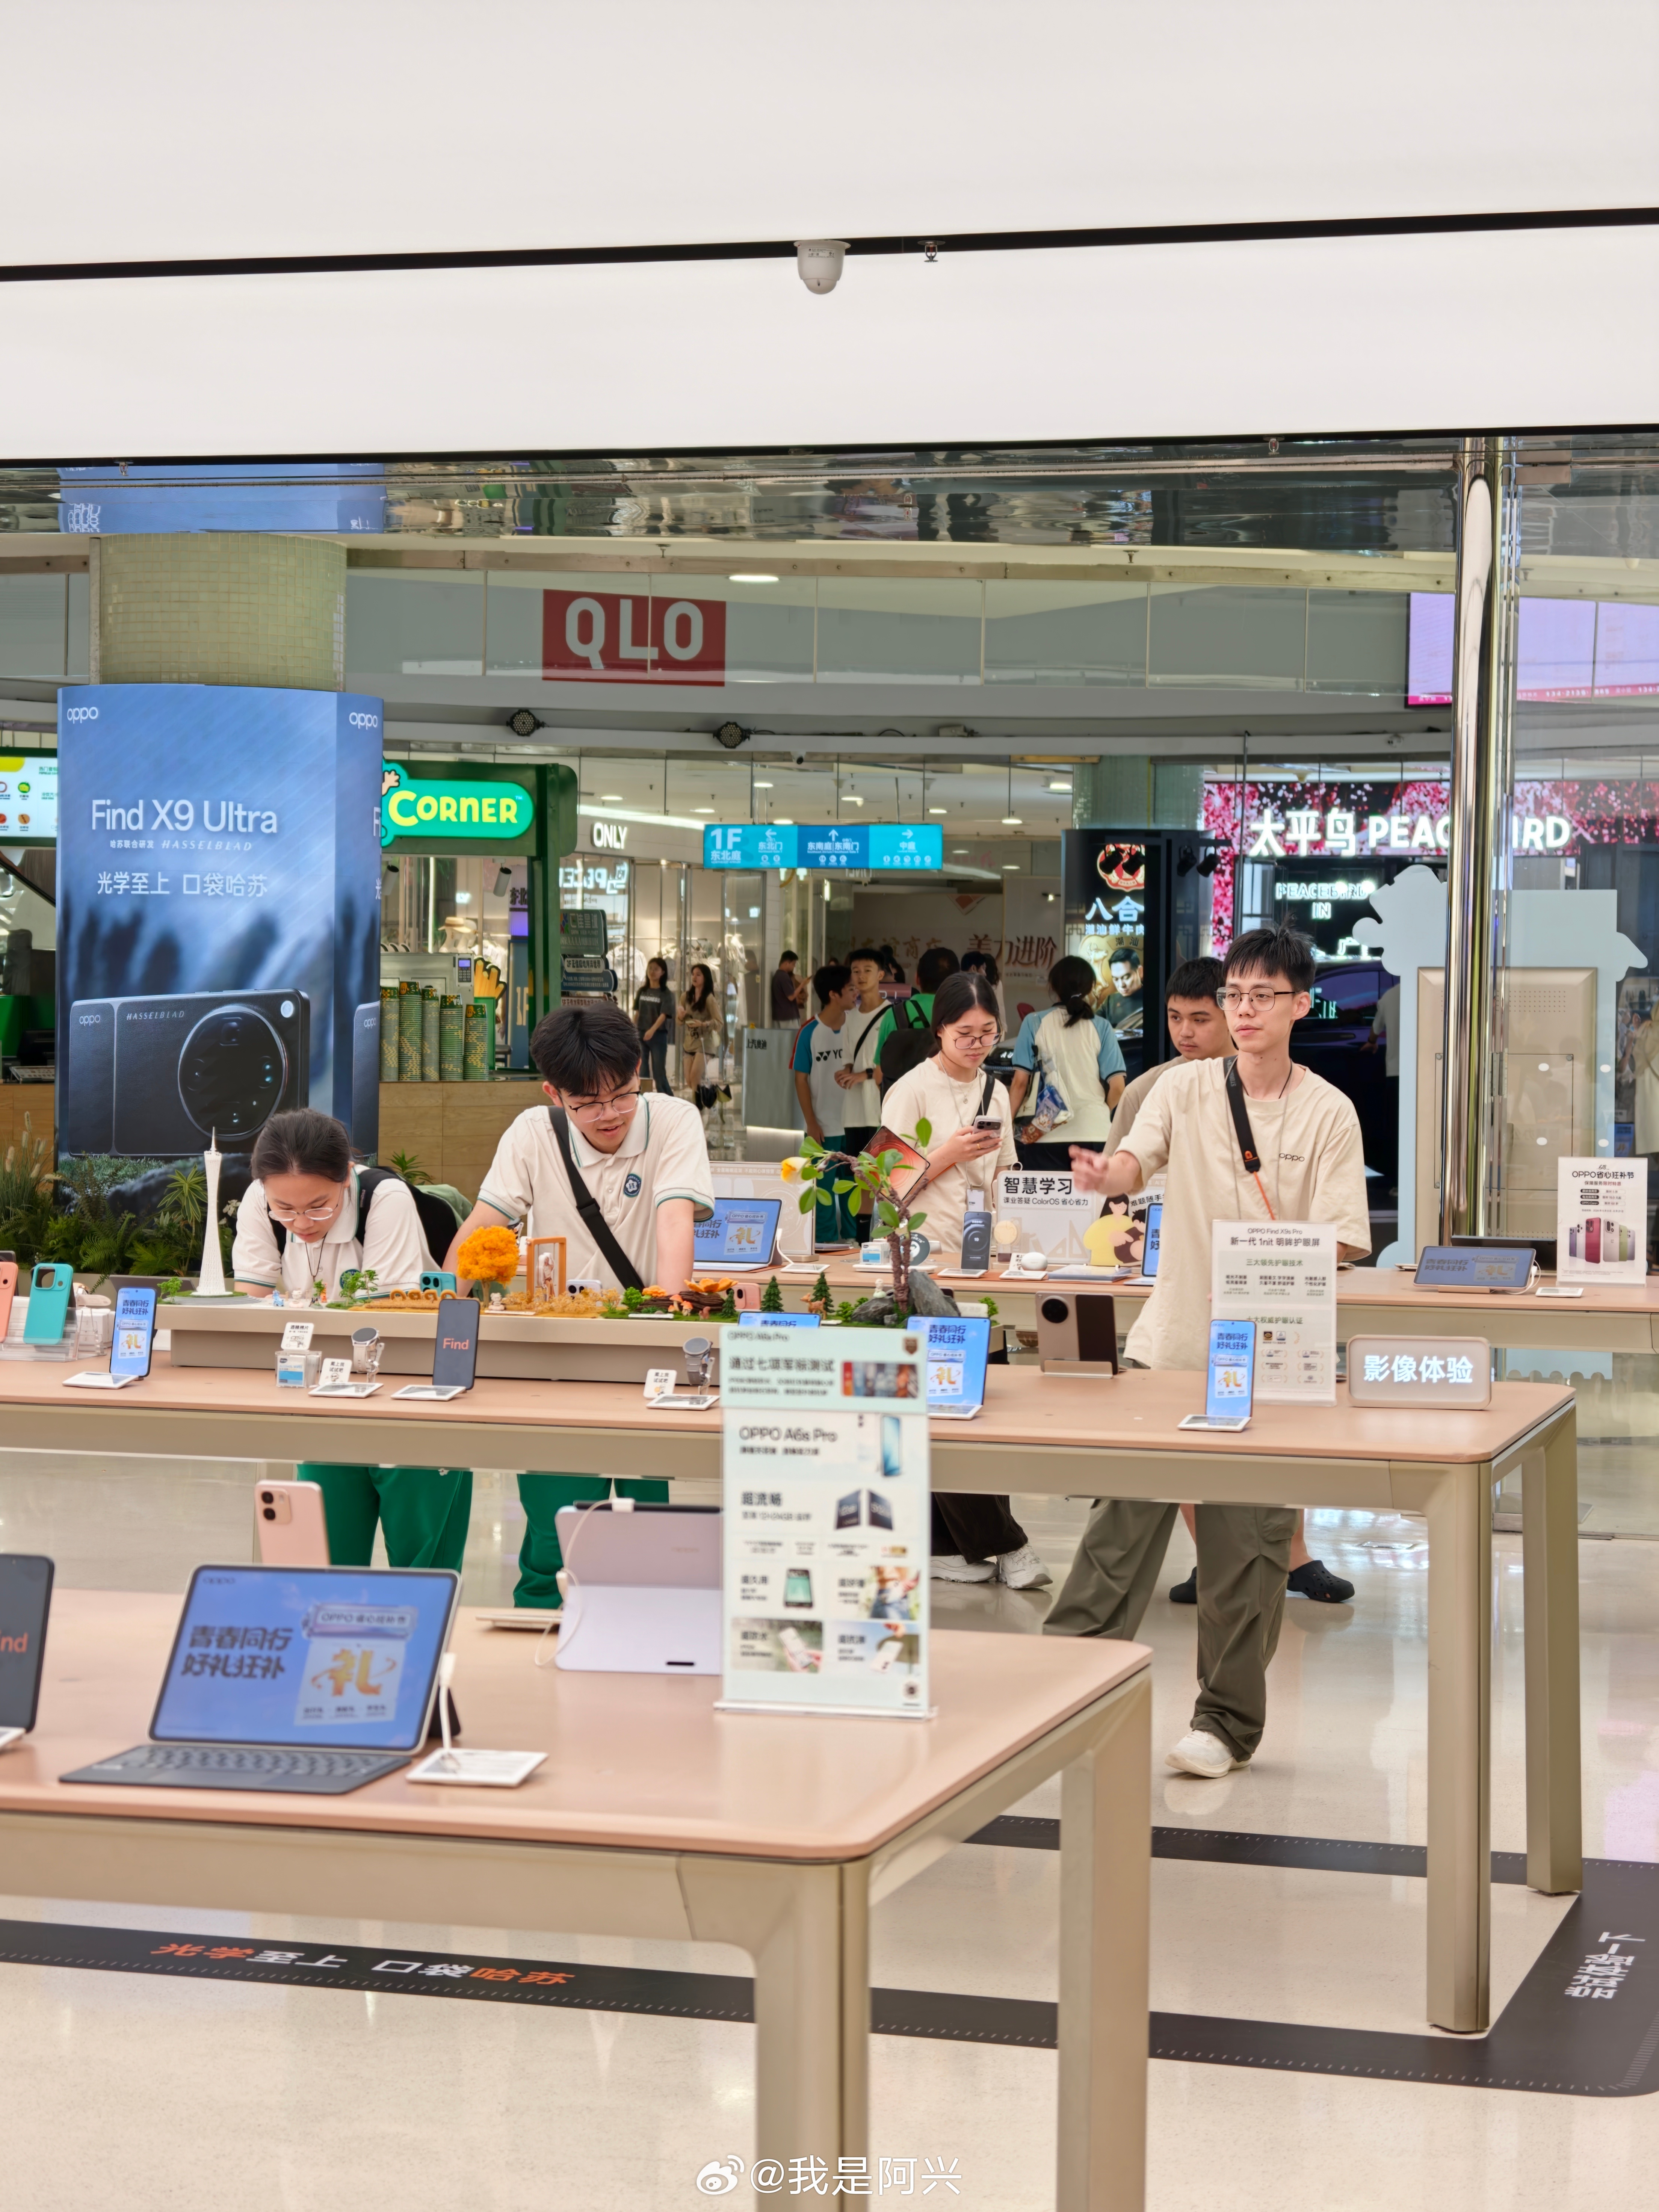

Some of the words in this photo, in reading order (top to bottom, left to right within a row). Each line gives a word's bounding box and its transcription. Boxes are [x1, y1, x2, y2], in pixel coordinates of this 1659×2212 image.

[565, 597, 703, 669] QLO
[67, 706, 98, 723] oppo
[349, 711, 378, 729] oppo
[92, 799, 143, 830] Find
[151, 799, 194, 831] X9
[203, 801, 278, 833] Ultra
[388, 790, 518, 826] CORNER
[593, 822, 628, 849] ONLY
[710, 828, 742, 850] 1F
[1248, 808, 1356, 857] 太平鸟
[110, 839, 154, 849] 哈苏联合研发
[162, 840, 263, 852] HASSELBLAD
[758, 842, 783, 851] 东北门
[807, 842, 833, 851] 东南庭
[834, 842, 859, 851] 东南门
[899, 841, 916, 850] 中庭
[710, 850, 742, 860] 东北庭
[97, 872, 170, 895] 光学至上
[183, 873, 268, 897] 口袋哈苏
[1312, 902, 1332, 919] IN
[79, 1014, 101, 1026] oppo
[126, 1010, 185, 1021] HASSELBLAD
[746, 1038, 767, 1050] 上汽奥迪
[1279, 1153, 1305, 1162] oppo
[1572, 1171, 1634, 1179] OPPO省心狂补节
[1004, 1177, 1073, 1195] 智慧学习
[1130, 1194, 1164, 1207] 难题随手
[735, 1227, 756, 1245] 礼
[1230, 1237, 1257, 1246] 新一代
[1276, 1237, 1320, 1247] 明眸护眼屏
[1246, 1259, 1304, 1267] 三大领先护眼技术
[1485, 1265, 1508, 1276] 礼
[929, 1325, 967, 1334] 青春同行
[1217, 1333, 1248, 1341] 青春同行
[125, 1334, 142, 1349] 礼
[443, 1338, 469, 1350] Find
[1216, 1342, 1248, 1350] 好礼狂补
[935, 1366, 956, 1385] 礼
[1363, 1355, 1473, 1383] 影像体验
[1223, 1370, 1242, 1388] 礼
[739, 1426, 781, 1441] OPPO
[783, 1427, 810, 1441] A6s
[813, 1427, 838, 1443] Pro
[189, 1625, 294, 1651] 青春同行
[181, 1653, 285, 1680] 好礼狂补
[328, 1648, 382, 1697] 礼
[151, 1943, 349, 1969] 光学至上
[370, 1960, 576, 1986] 口袋哈苏
